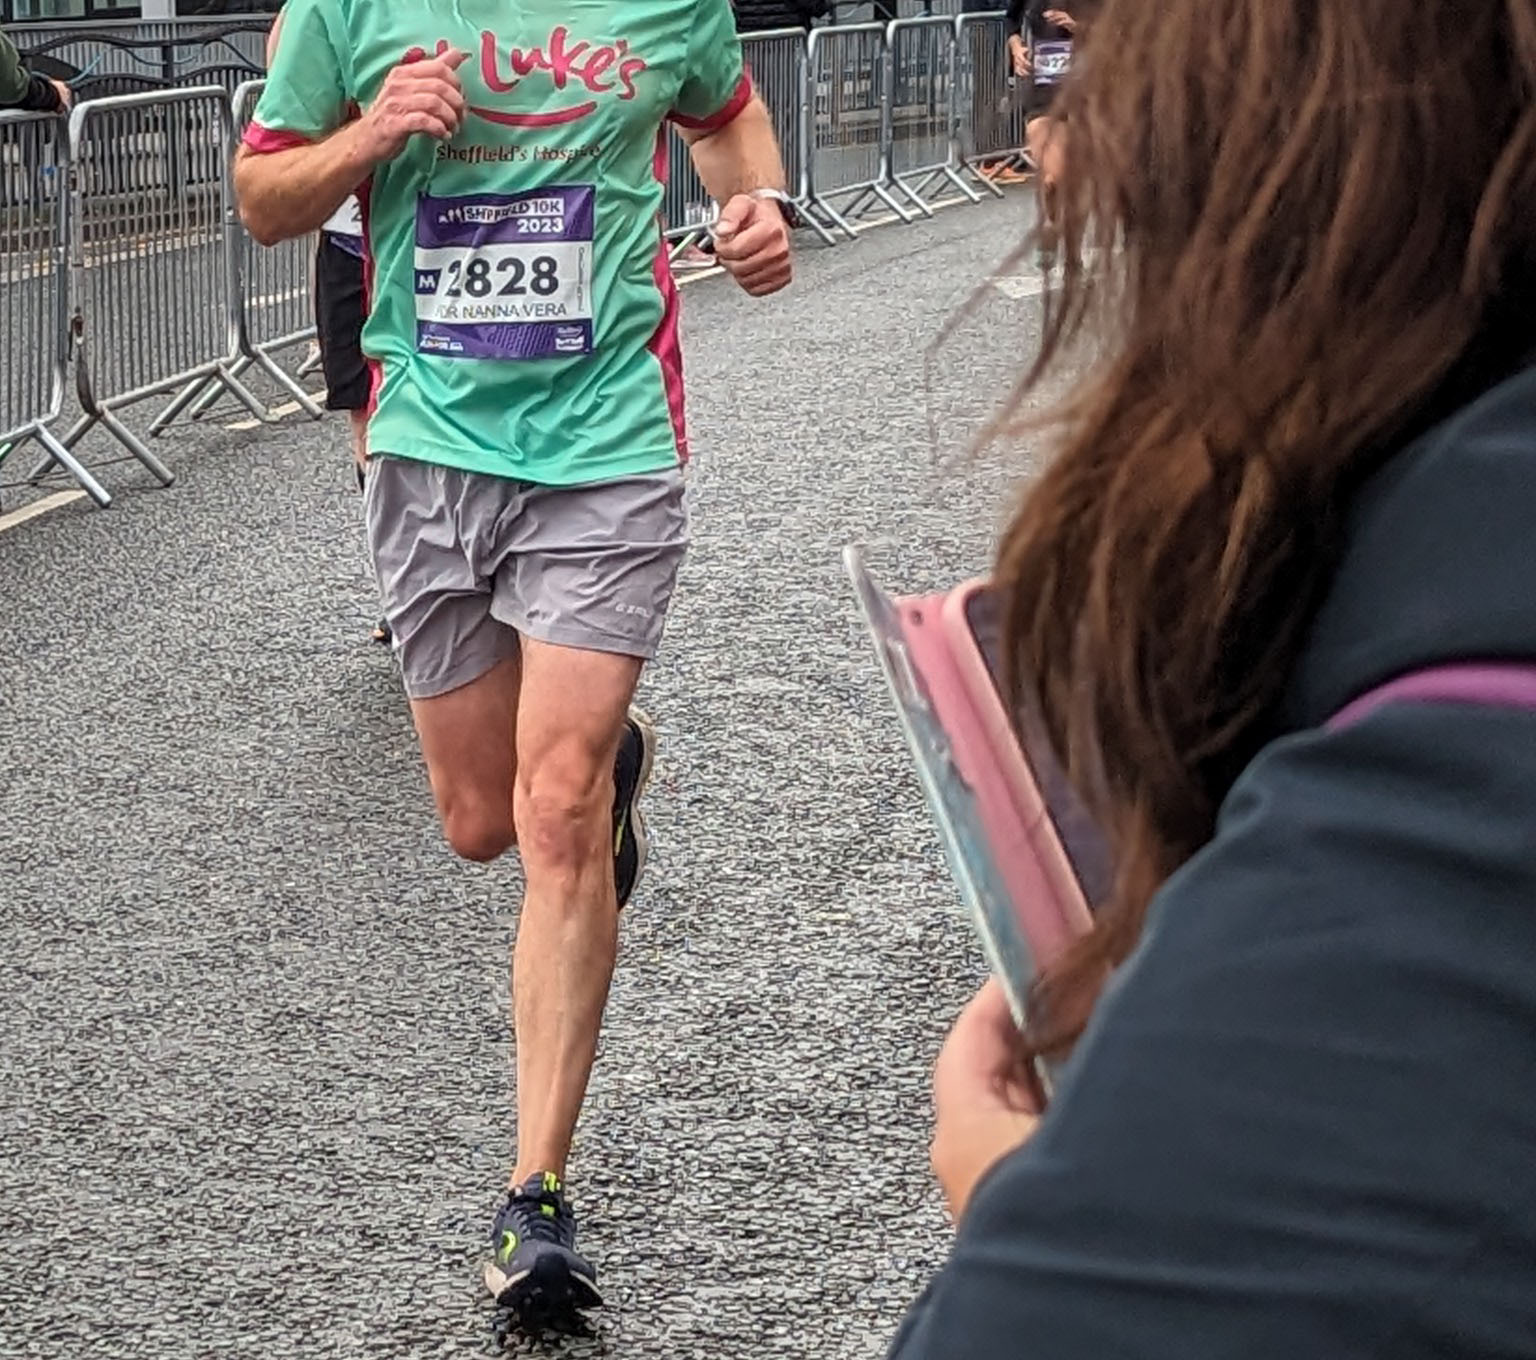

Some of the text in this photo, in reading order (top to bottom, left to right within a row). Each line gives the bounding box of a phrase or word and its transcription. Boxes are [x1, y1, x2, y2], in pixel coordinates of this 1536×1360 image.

[480, 25, 647, 100] Luke's
[532, 199, 561, 214] 10K
[516, 218, 564, 233] 2023
[444, 255, 559, 298] 2828
[462, 304, 519, 319] NANNA
[522, 302, 567, 317] VERA
